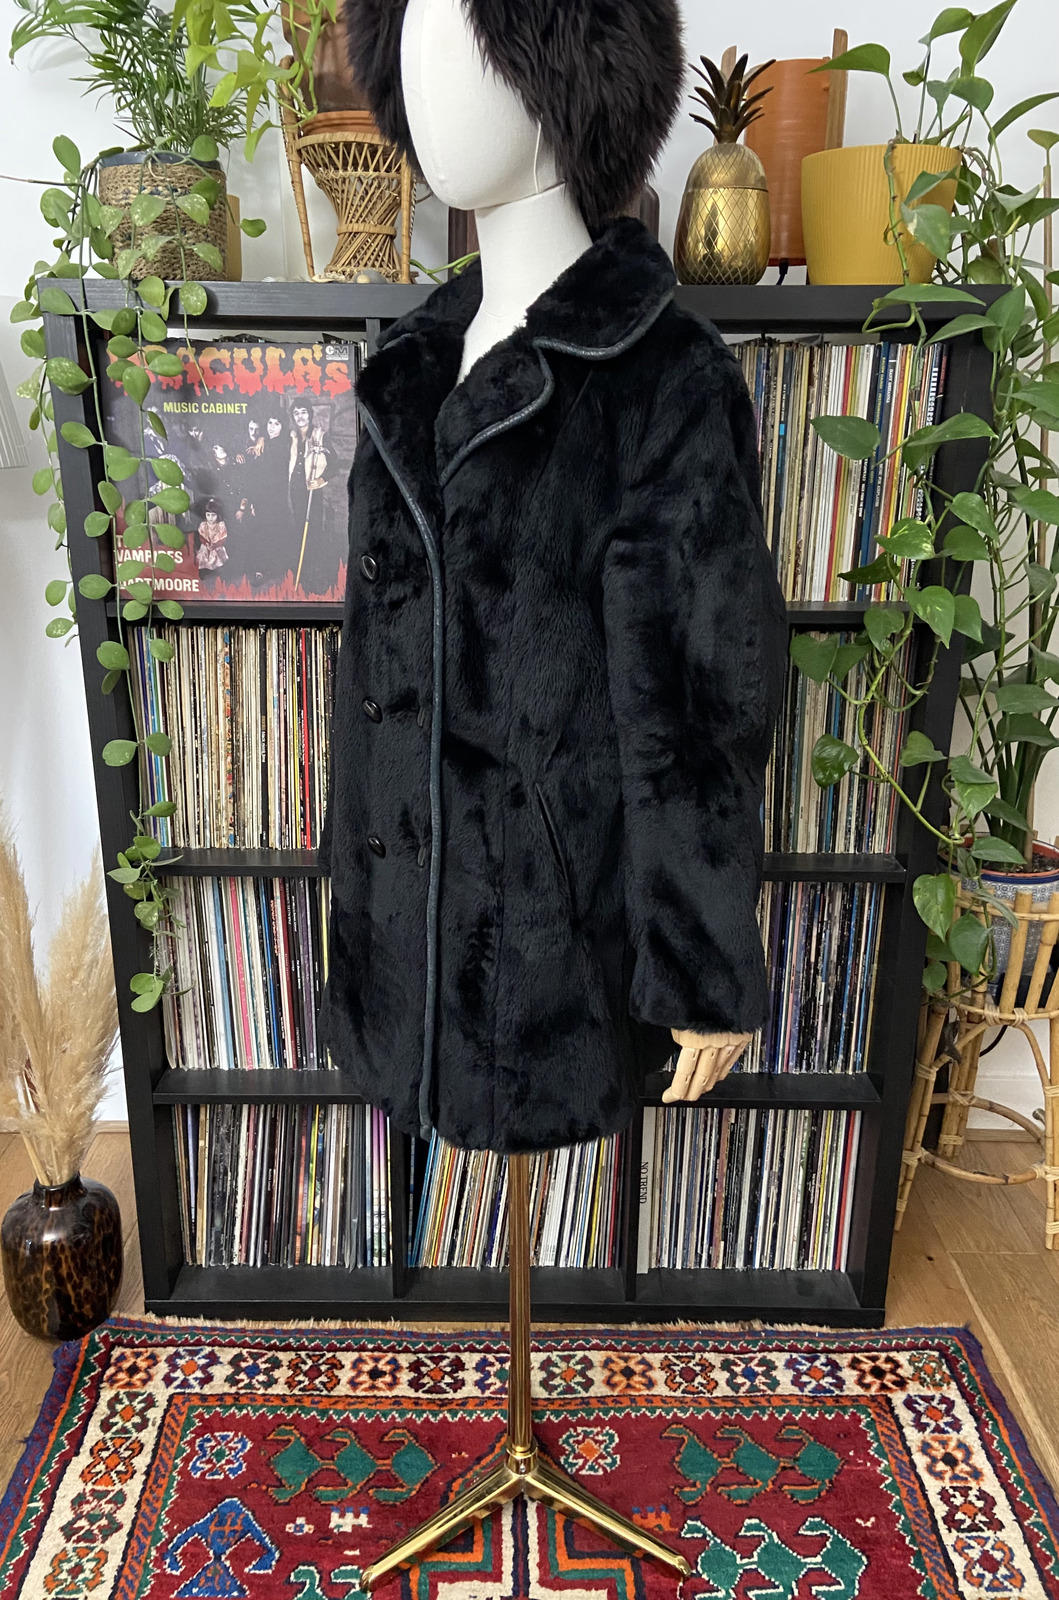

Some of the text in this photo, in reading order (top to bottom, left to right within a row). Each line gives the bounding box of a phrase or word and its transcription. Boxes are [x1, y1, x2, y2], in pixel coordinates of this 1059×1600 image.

[106, 344, 352, 400] ACULA'S
[163, 402, 248, 414] MUSIC CABINET
[116, 549, 184, 564] VAMPIES
[639, 1161, 648, 1204] NO TREND
